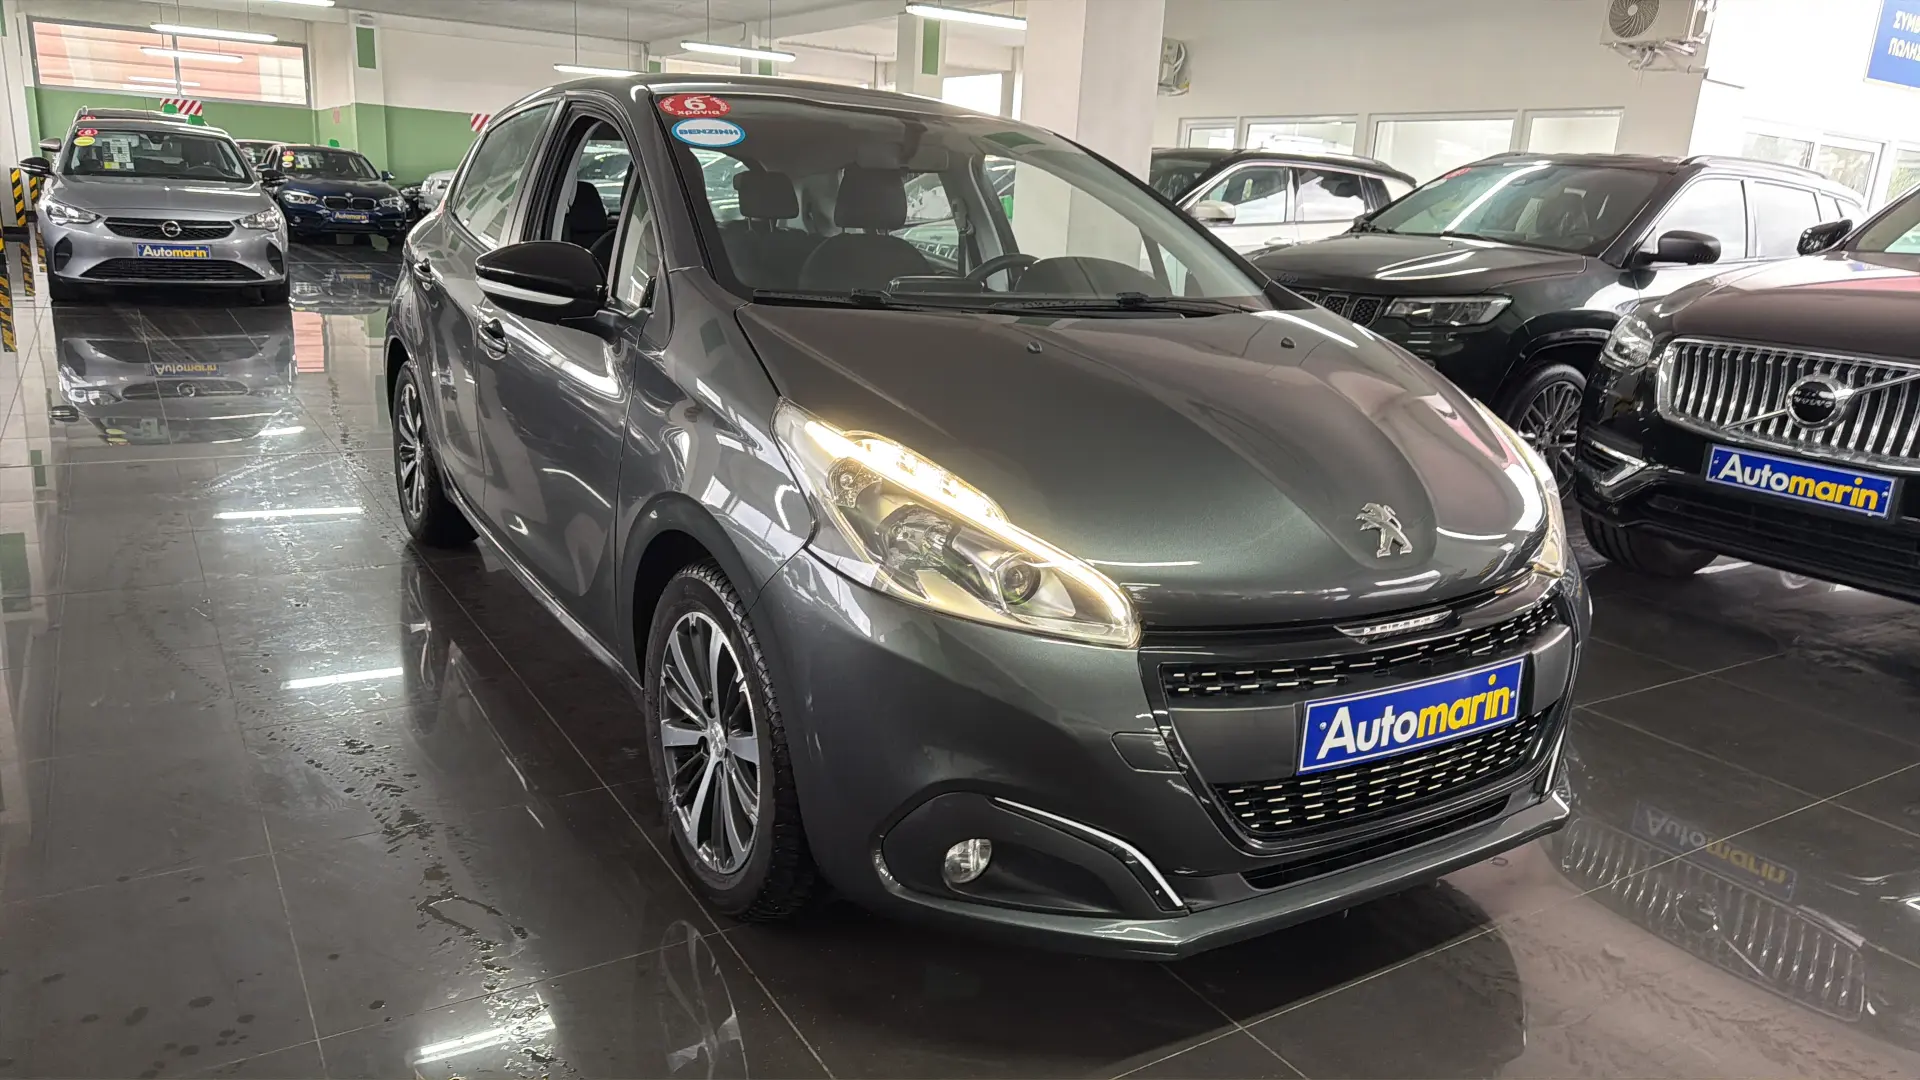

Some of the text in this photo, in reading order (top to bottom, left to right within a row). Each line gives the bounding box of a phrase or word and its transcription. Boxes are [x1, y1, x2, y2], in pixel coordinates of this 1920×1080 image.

[684, 96, 708, 110] 6
[142, 245, 207, 258] Automarin
[1717, 454, 1878, 510] Automarin
[1316, 674, 1510, 760] Automarin
